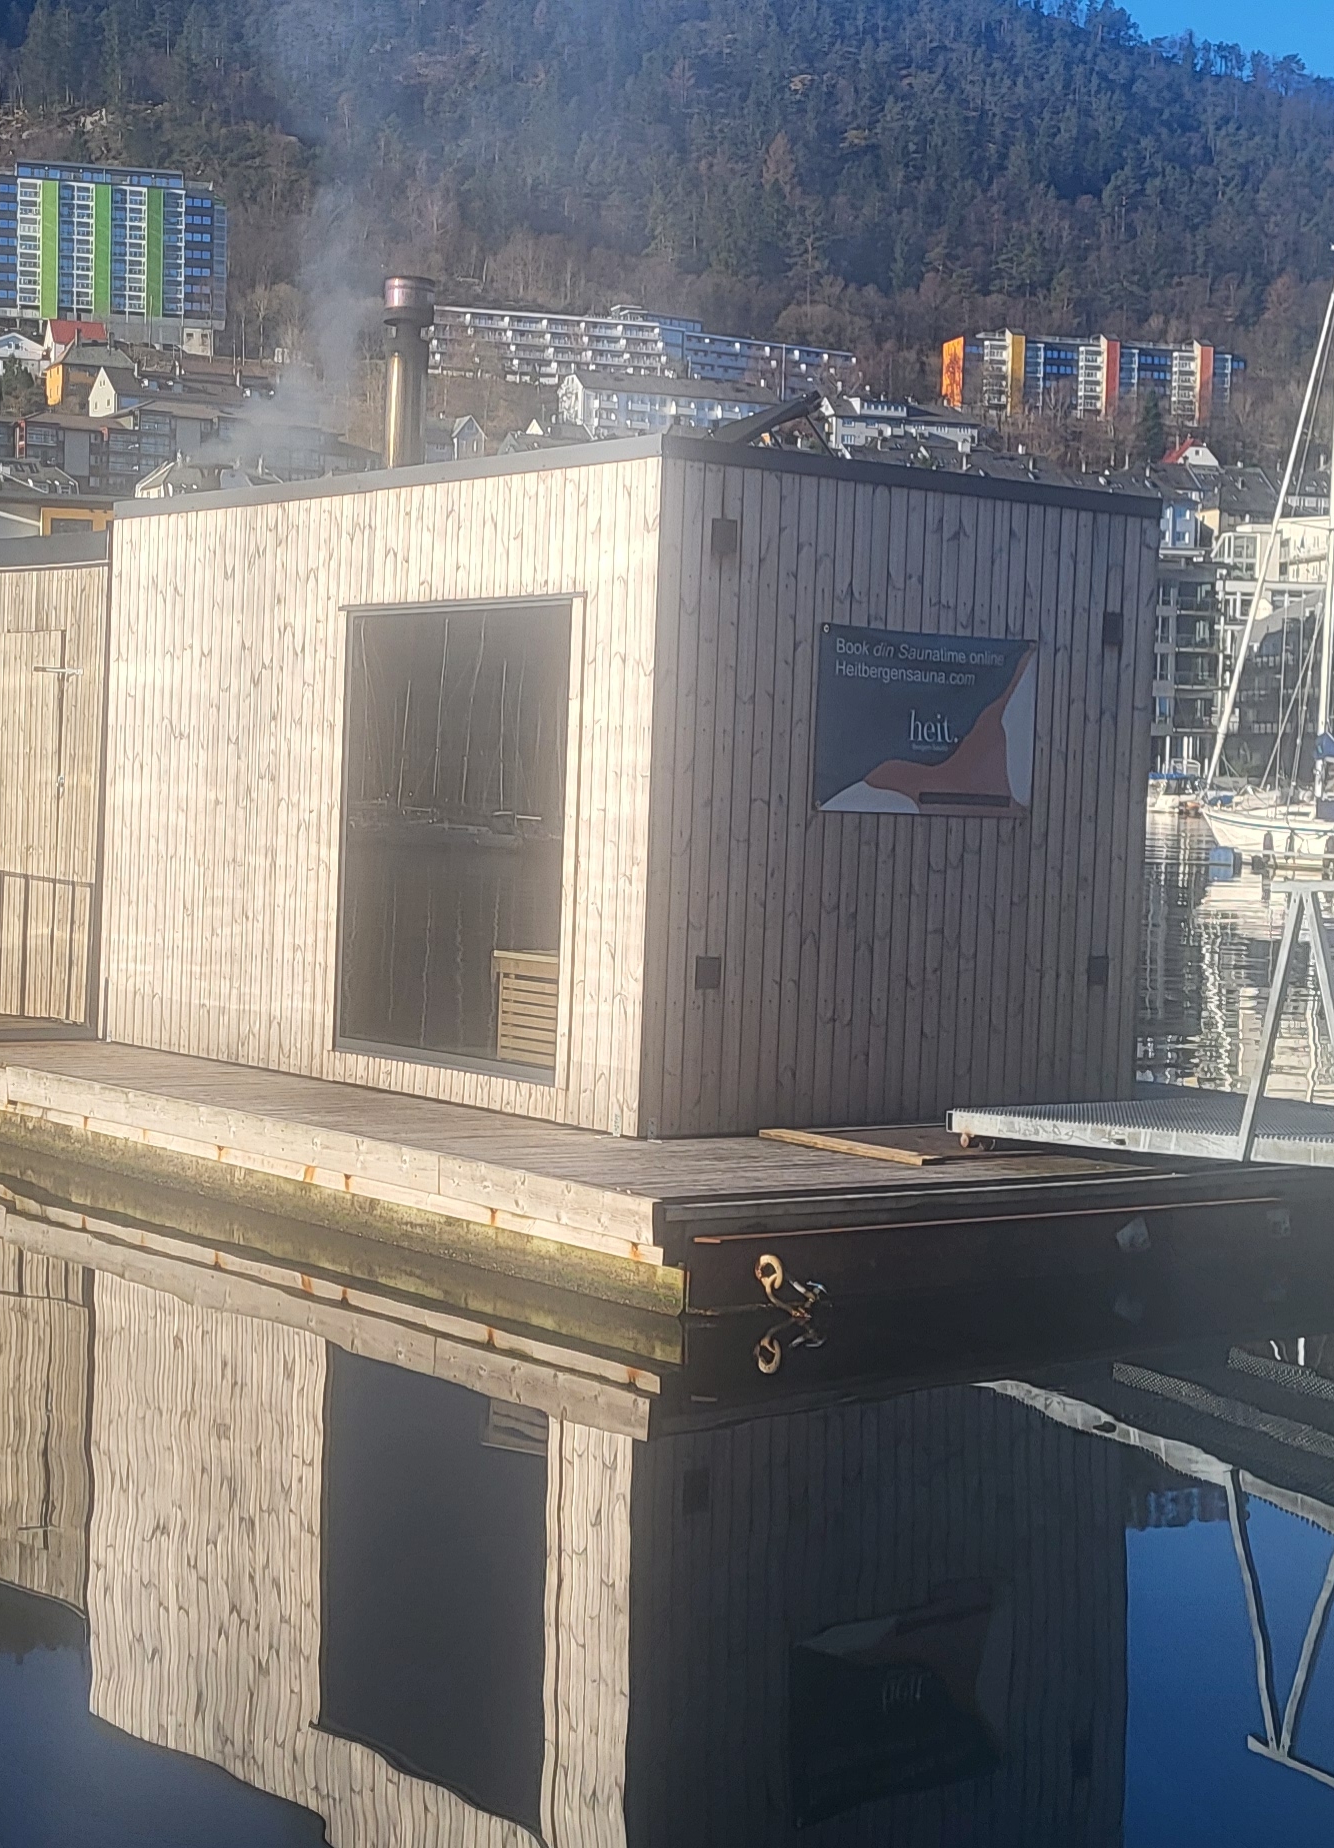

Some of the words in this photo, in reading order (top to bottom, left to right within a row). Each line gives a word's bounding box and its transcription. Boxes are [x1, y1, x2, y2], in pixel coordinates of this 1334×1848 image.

[836, 637, 870, 656] Book
[873, 642, 895, 658] din
[898, 643, 966, 664] Saunatime
[969, 650, 1005, 667] online
[835, 659, 975, 687] Heitbergensauna.com
[908, 709, 959, 744] heit.
